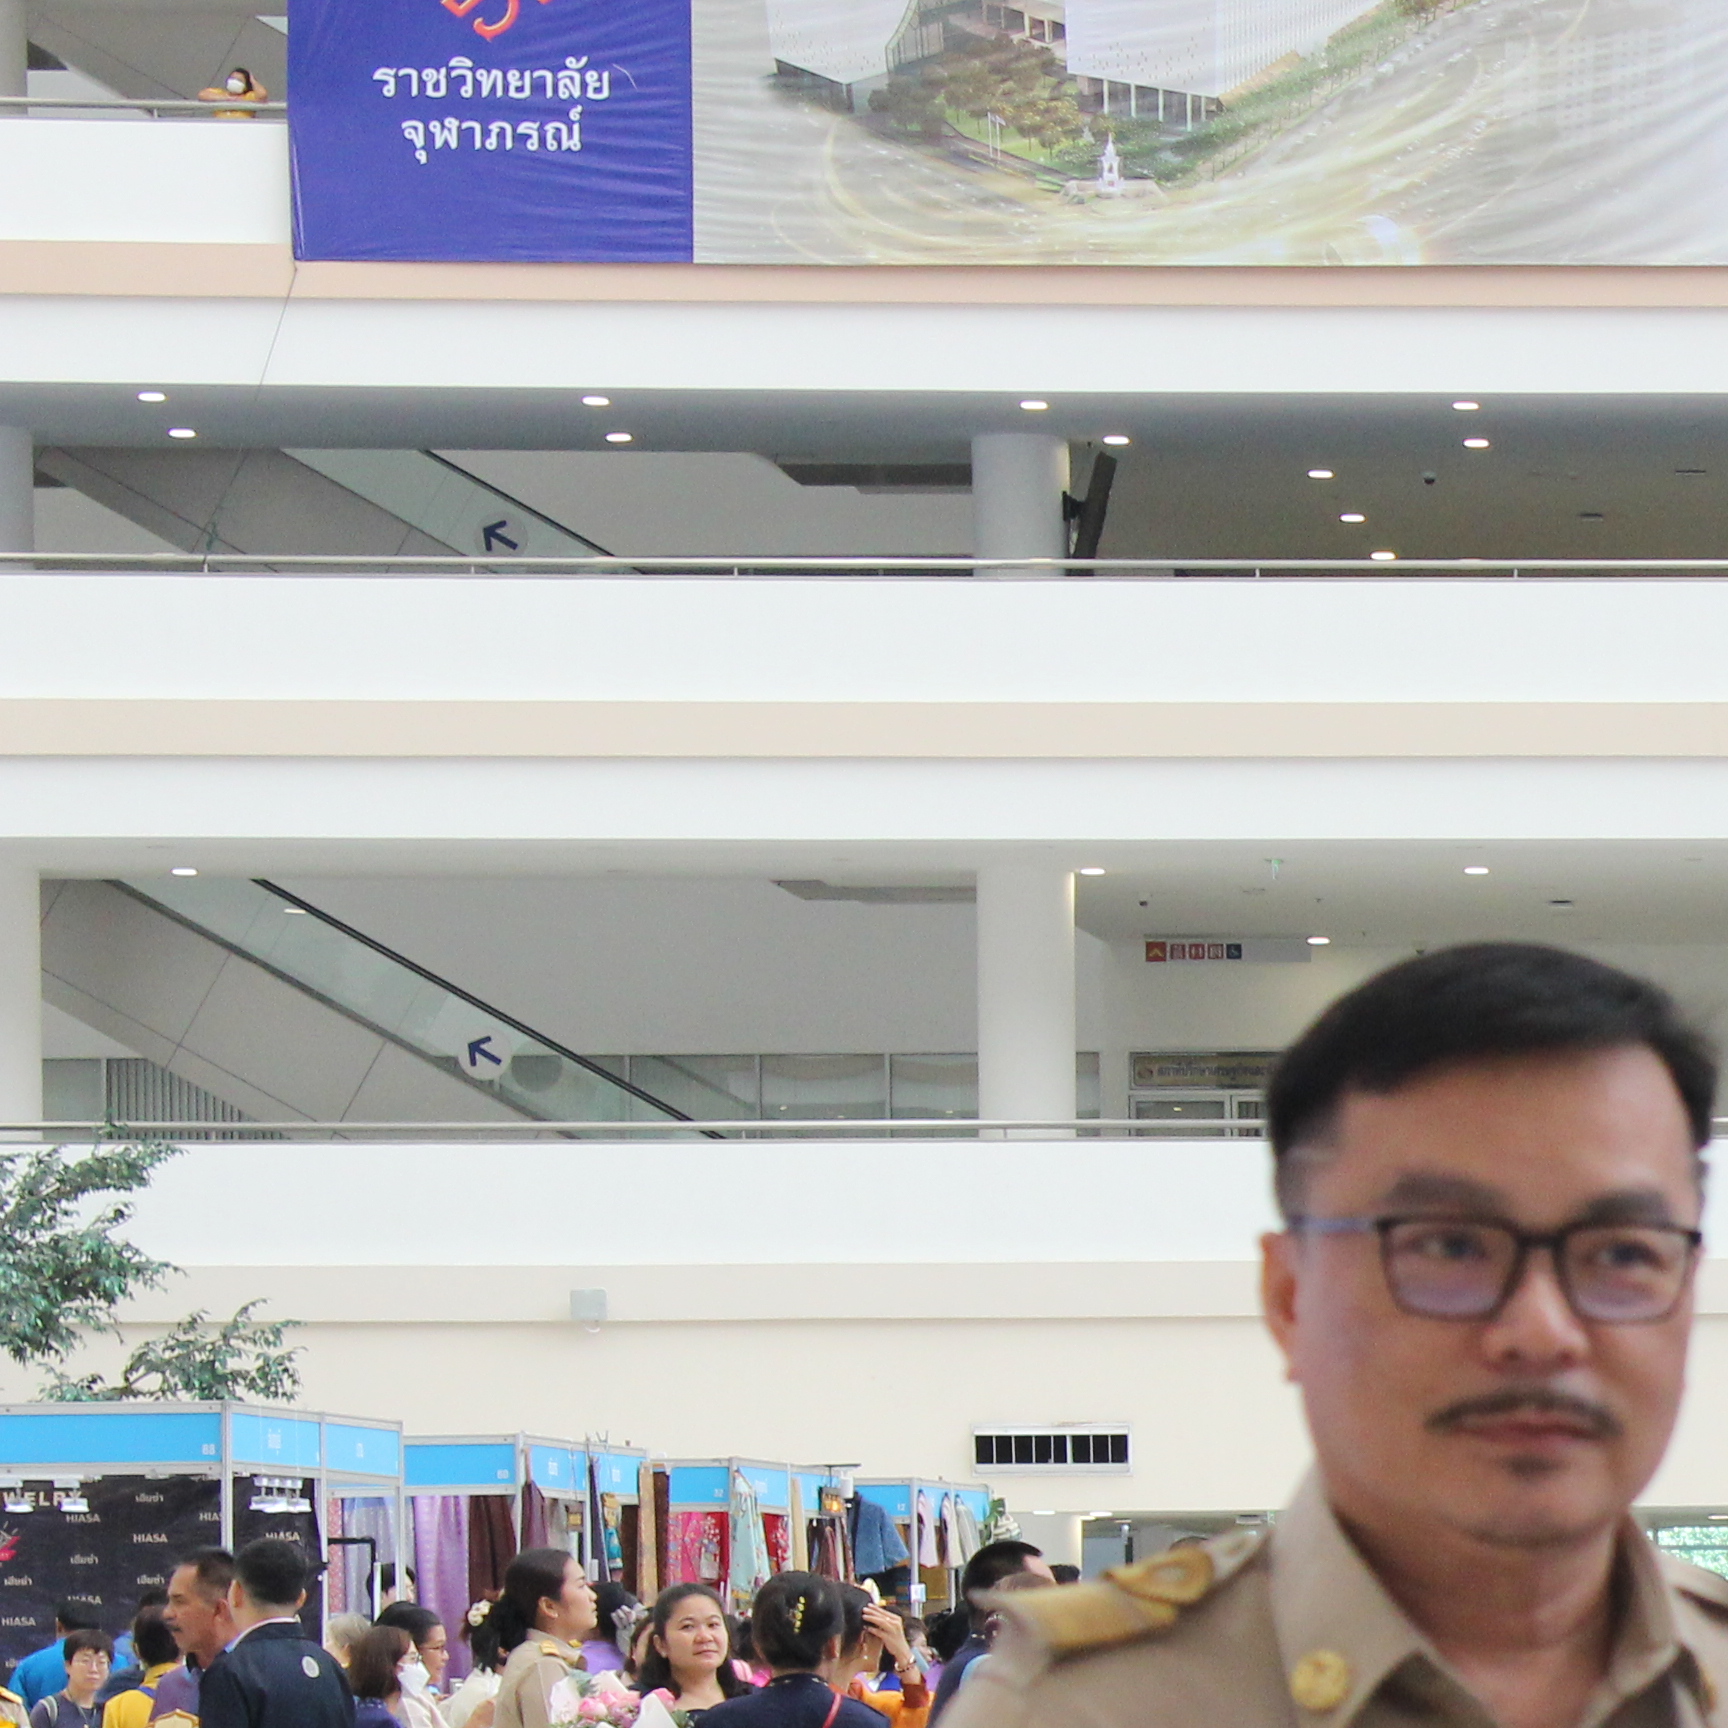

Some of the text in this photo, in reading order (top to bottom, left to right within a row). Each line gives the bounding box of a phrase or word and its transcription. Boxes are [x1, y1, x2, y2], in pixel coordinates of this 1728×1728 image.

[372, 56, 610, 100] ราชวิทยาลัย
[401, 104, 583, 165] จุฬาภรณ์
[66, 1513, 101, 1524] HIASA
[199, 1511, 222, 1522] HIA
[133, 1533, 168, 1544] HIASA
[1, 1616, 36, 1627] HIASA
